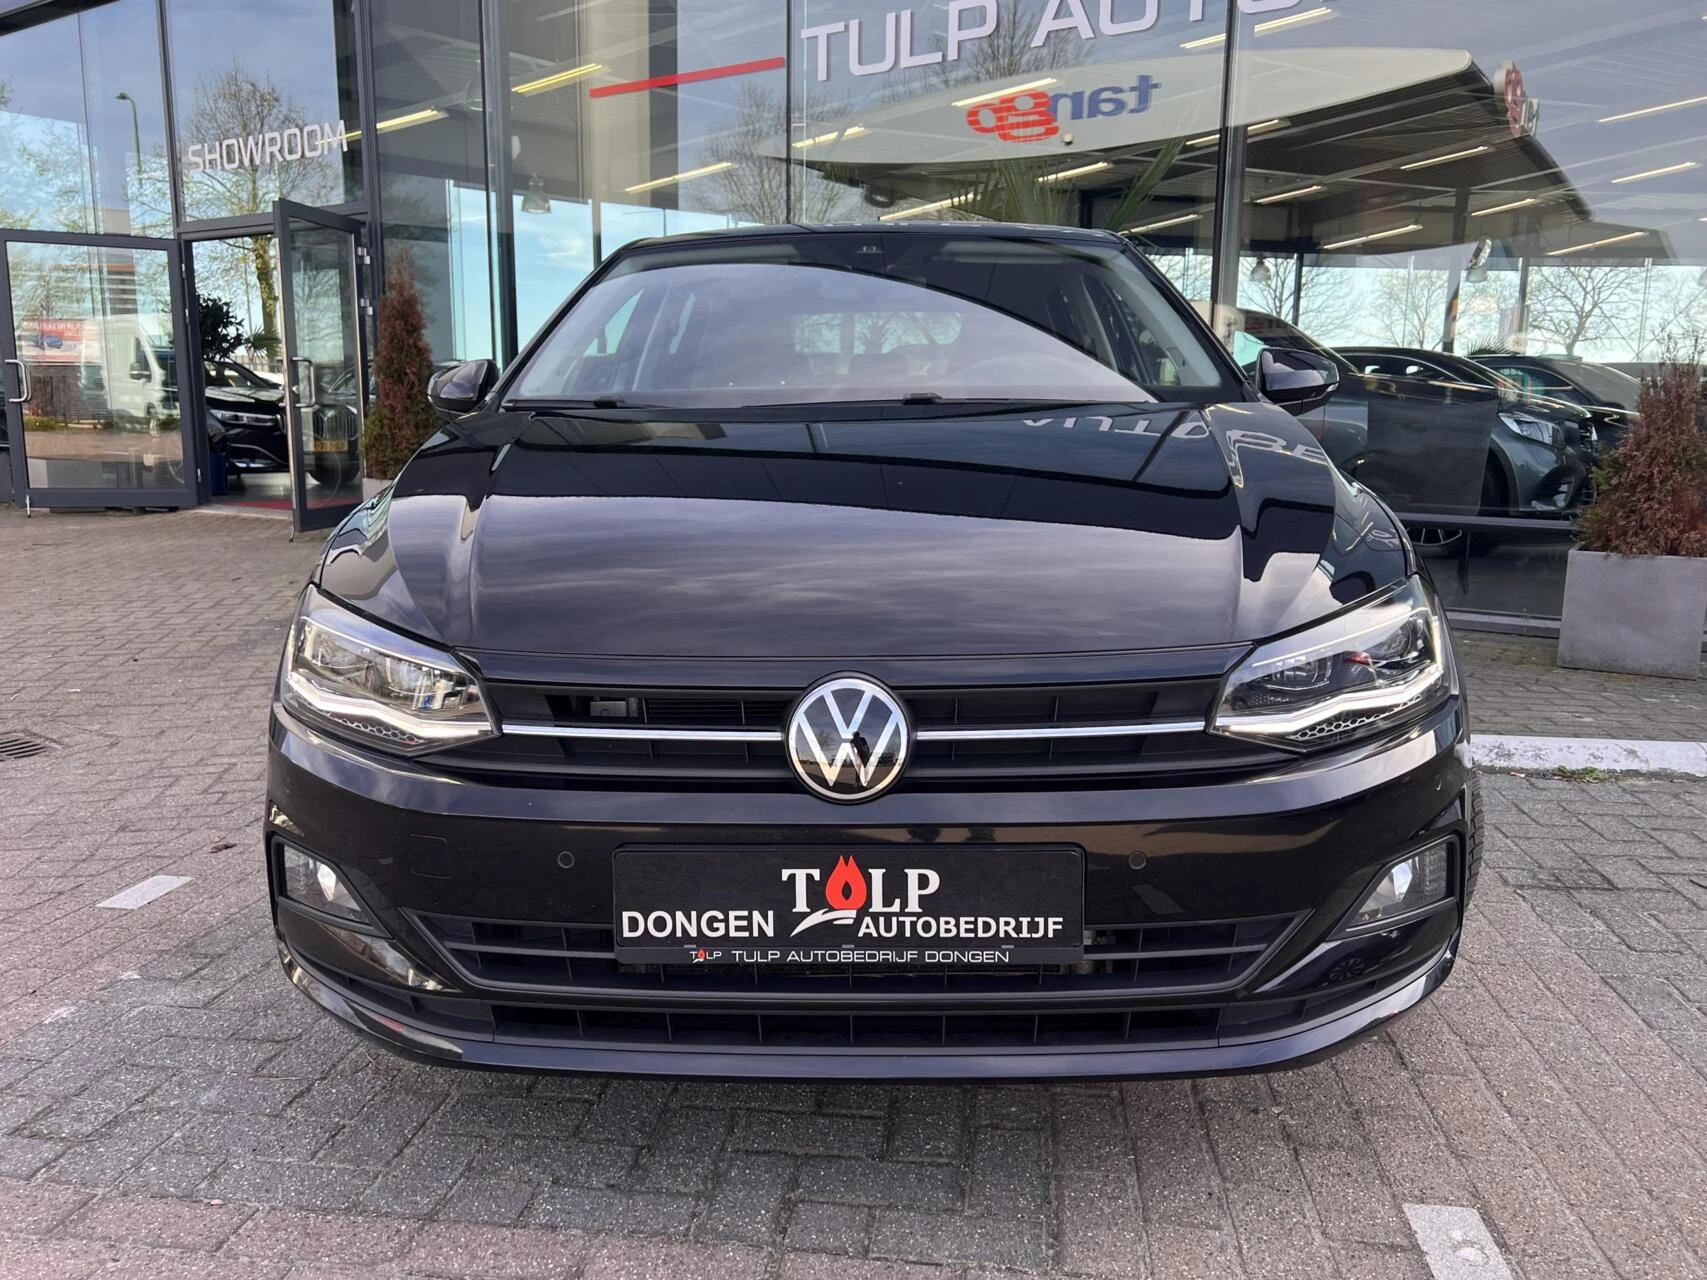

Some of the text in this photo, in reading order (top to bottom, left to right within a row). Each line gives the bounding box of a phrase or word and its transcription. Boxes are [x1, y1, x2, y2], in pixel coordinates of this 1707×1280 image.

[801, 0, 1302, 81] TULP AU
[188, 119, 348, 174] SHOWROOM
[621, 910, 1064, 939] DONGEN AUTOBEDRIJF
[731, 950, 780, 963] TULP
[786, 950, 919, 963] AUTOBEDRIJF
[925, 950, 1009, 963] DONGEN
